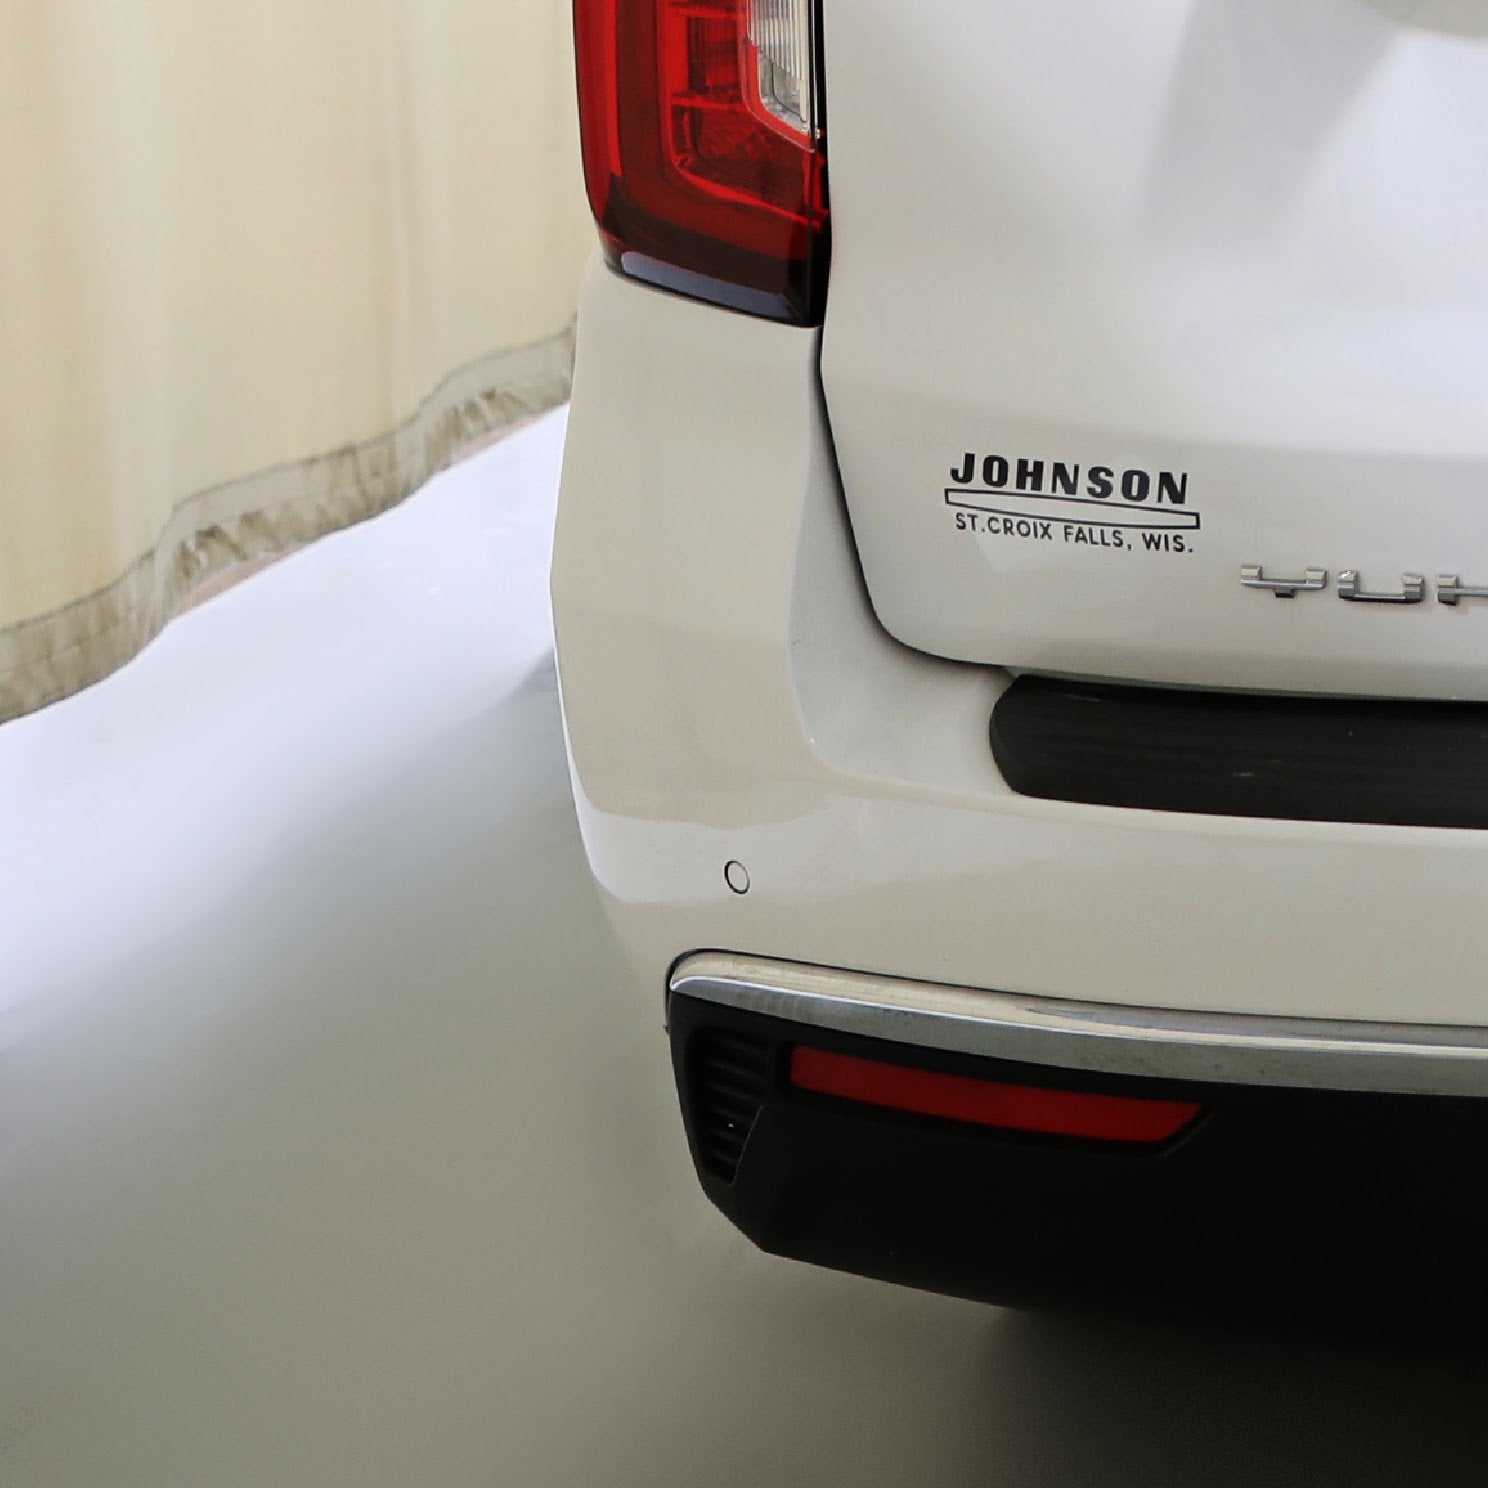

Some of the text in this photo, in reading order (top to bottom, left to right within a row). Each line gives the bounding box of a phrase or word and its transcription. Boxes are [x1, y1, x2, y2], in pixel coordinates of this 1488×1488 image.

[950, 453, 1187, 504] JOHNSON
[1064, 525, 1132, 551] FALLS,
[1141, 533, 1193, 553] WIS.
